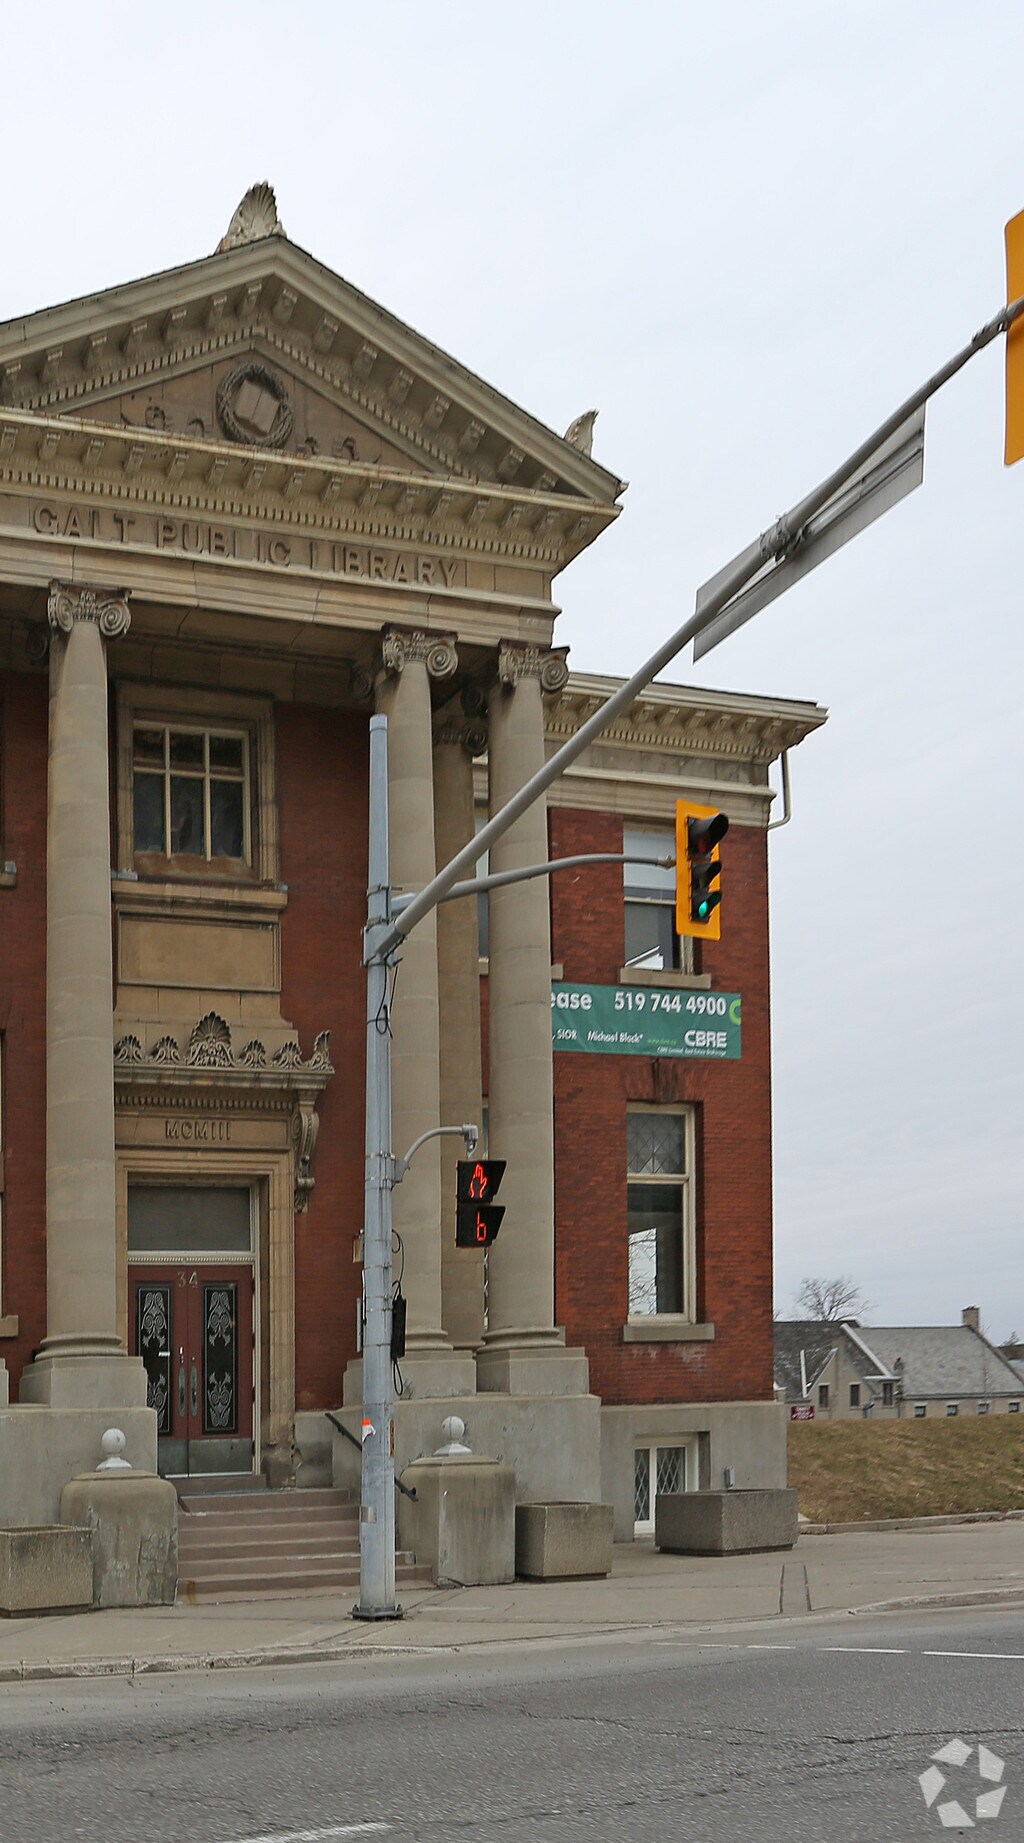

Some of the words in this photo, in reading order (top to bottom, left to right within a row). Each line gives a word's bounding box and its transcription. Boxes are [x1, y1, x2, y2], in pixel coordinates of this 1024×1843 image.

[34, 505, 135, 543] GALT
[157, 520, 291, 567] PUBLIC
[310, 541, 458, 588] LIBRARY
[614, 991, 646, 1011] 519
[650, 993, 682, 1013] 744
[686, 995, 727, 1016] 4900
[684, 1029, 728, 1048] CBRE
[165, 1119, 231, 1141] MCMIII
[177, 1271, 198, 1289] 34
